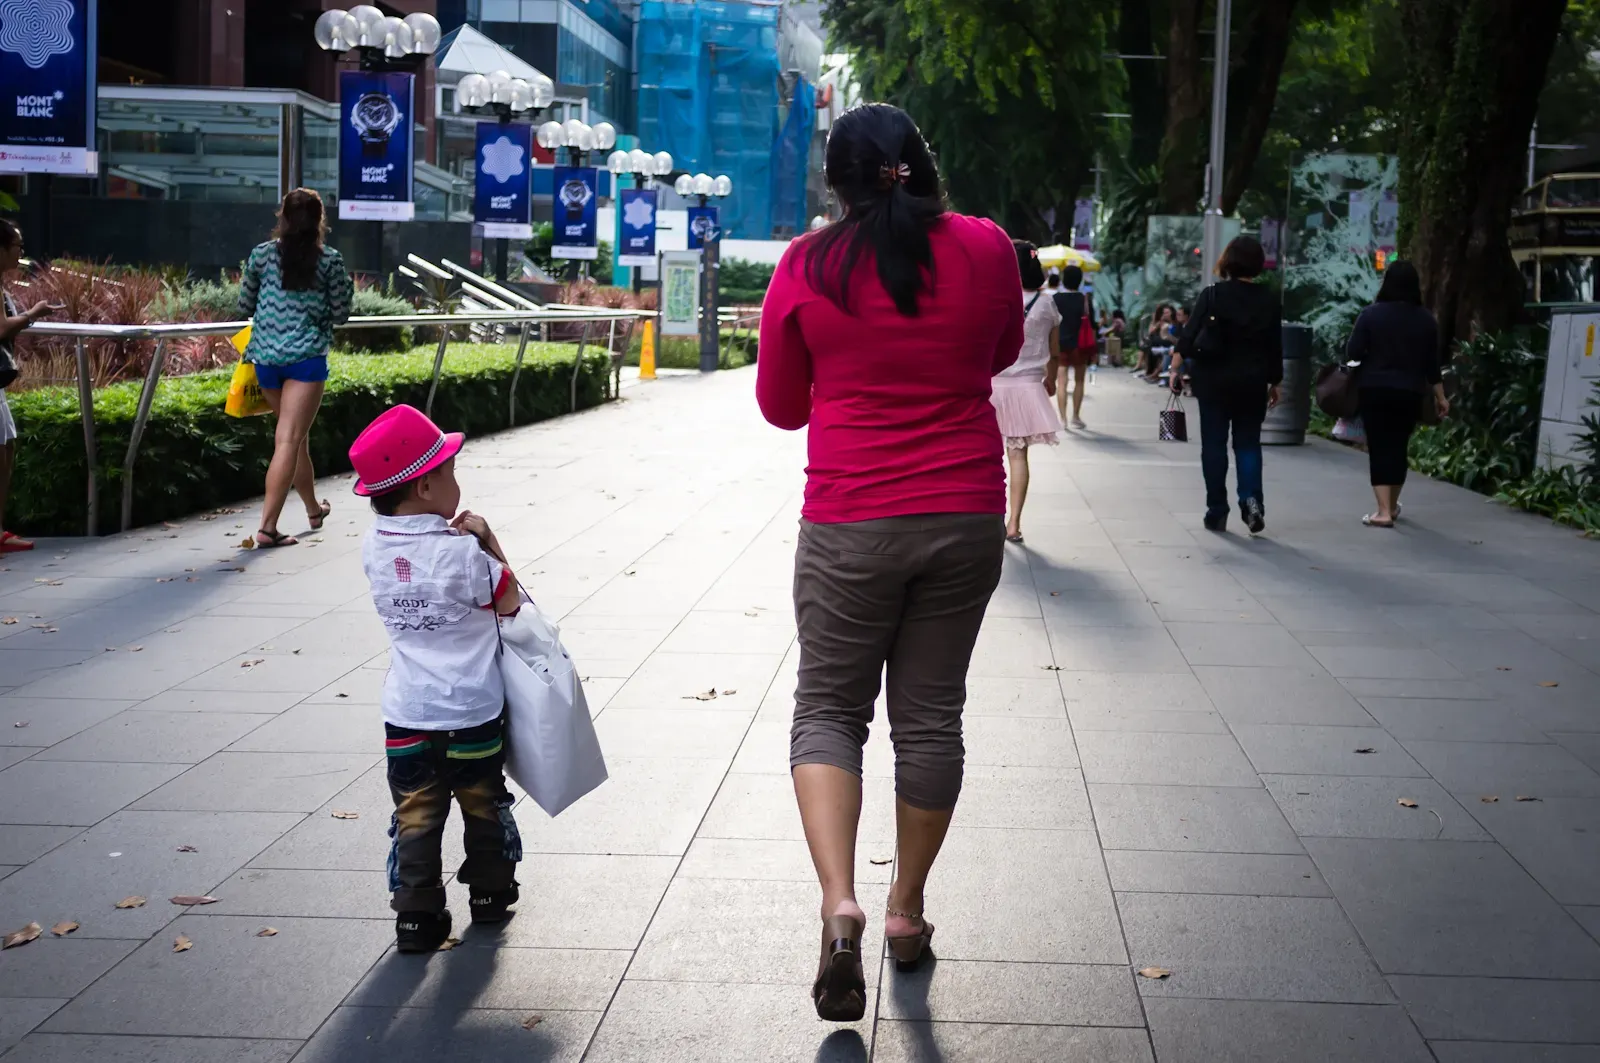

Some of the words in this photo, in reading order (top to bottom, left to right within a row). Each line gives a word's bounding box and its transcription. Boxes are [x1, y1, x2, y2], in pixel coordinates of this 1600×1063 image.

[17, 95, 53, 106] MONT
[17, 106, 53, 118] BLANC
[361, 166, 388, 175] MONT
[361, 174, 388, 183] BLANC
[392, 598, 429, 608] KGDL
